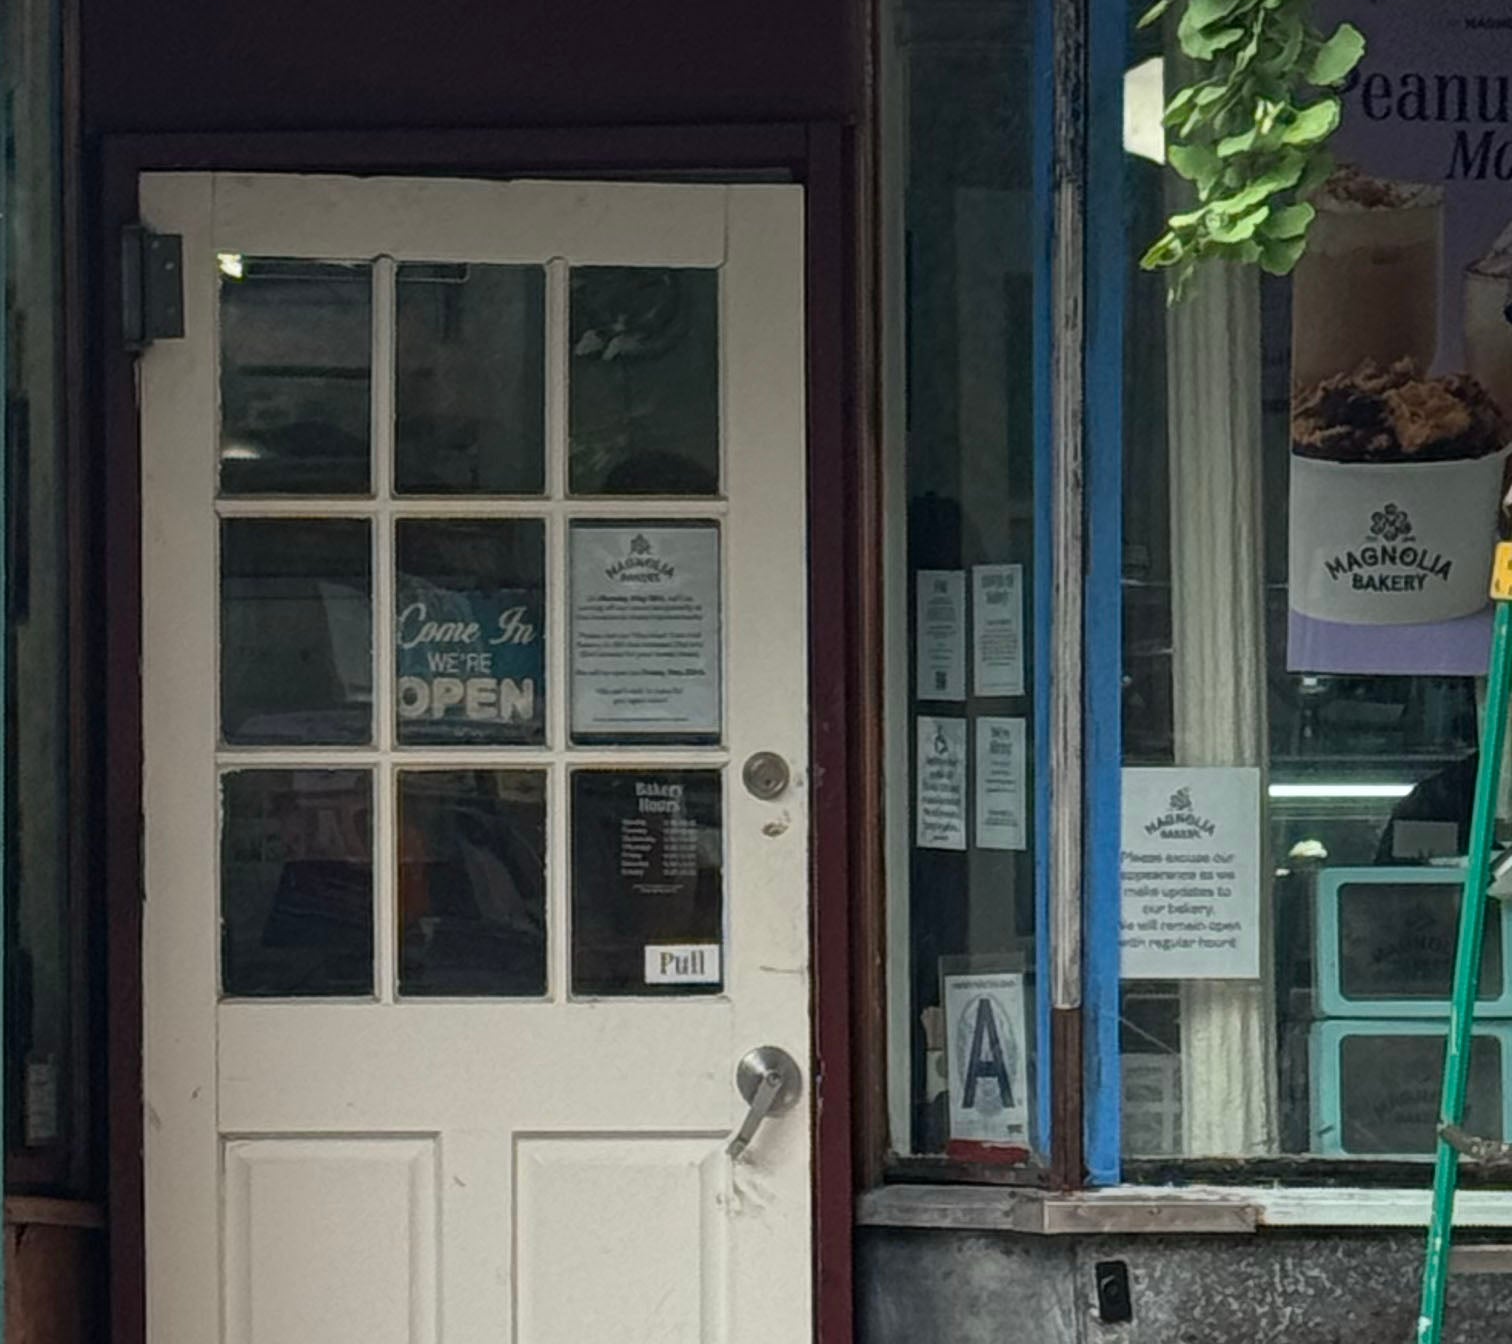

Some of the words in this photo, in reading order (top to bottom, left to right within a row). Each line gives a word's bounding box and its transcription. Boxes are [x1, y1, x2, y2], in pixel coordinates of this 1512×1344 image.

[1340, 67, 1509, 123] eanu
[1324, 542, 1454, 583] MAGNOLIA
[1352, 570, 1428, 593] BAKERY
[398, 602, 480, 650] Come
[490, 605, 536, 645] In
[427, 652, 493, 673] WE'RE
[399, 675, 534, 721] OPEN
[635, 781, 684, 798] Bakery
[638, 797, 681, 814] Hours
[1144, 812, 1216, 838] MAGNOLIA
[658, 950, 705, 976] Pull
[962, 997, 1015, 1110] A
